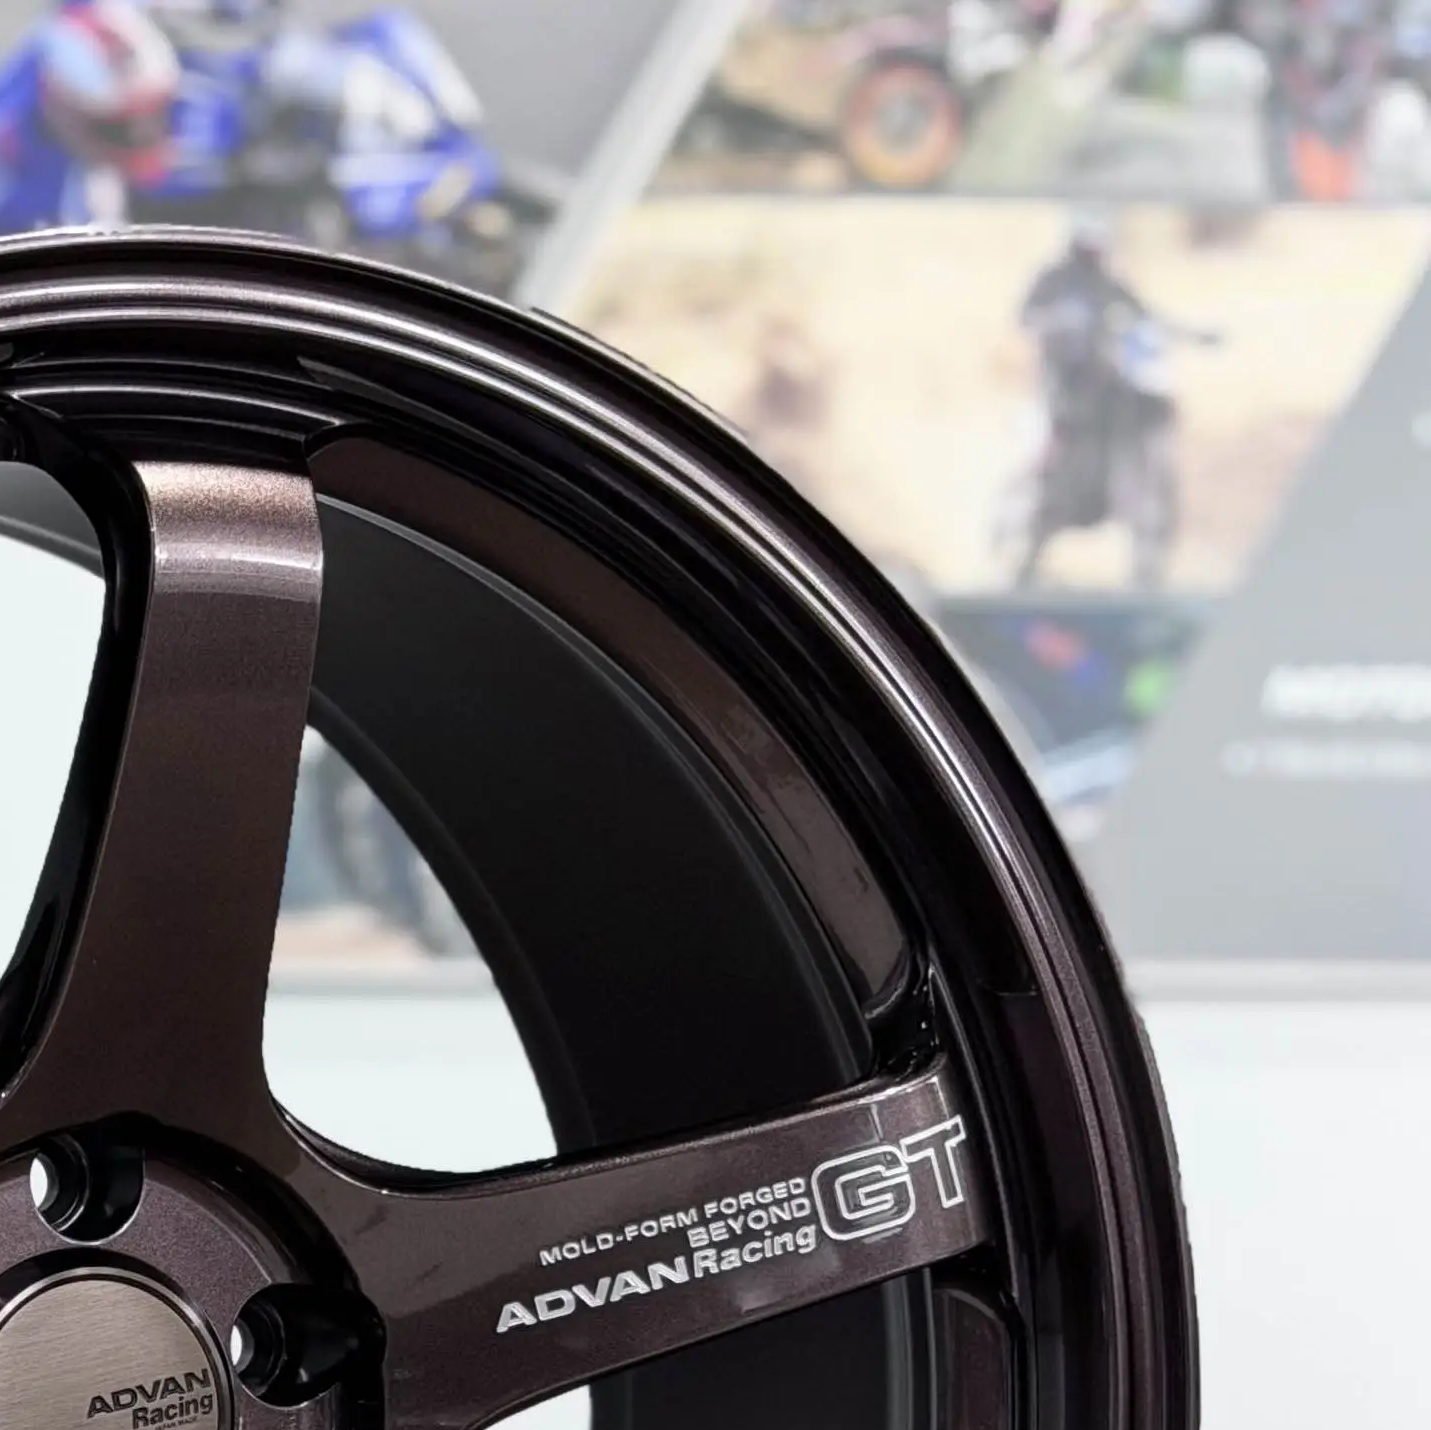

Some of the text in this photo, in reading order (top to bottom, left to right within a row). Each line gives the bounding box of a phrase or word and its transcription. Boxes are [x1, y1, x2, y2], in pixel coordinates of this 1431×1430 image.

[811, 1114, 966, 1241] GT
[539, 1177, 807, 1266] MOLD-FORM FORGED
[686, 1197, 812, 1249] BEYOND
[496, 1224, 817, 1333] ADVAN Racing
[87, 1368, 211, 1419] ADVAN
[132, 1393, 213, 1430] Racing
